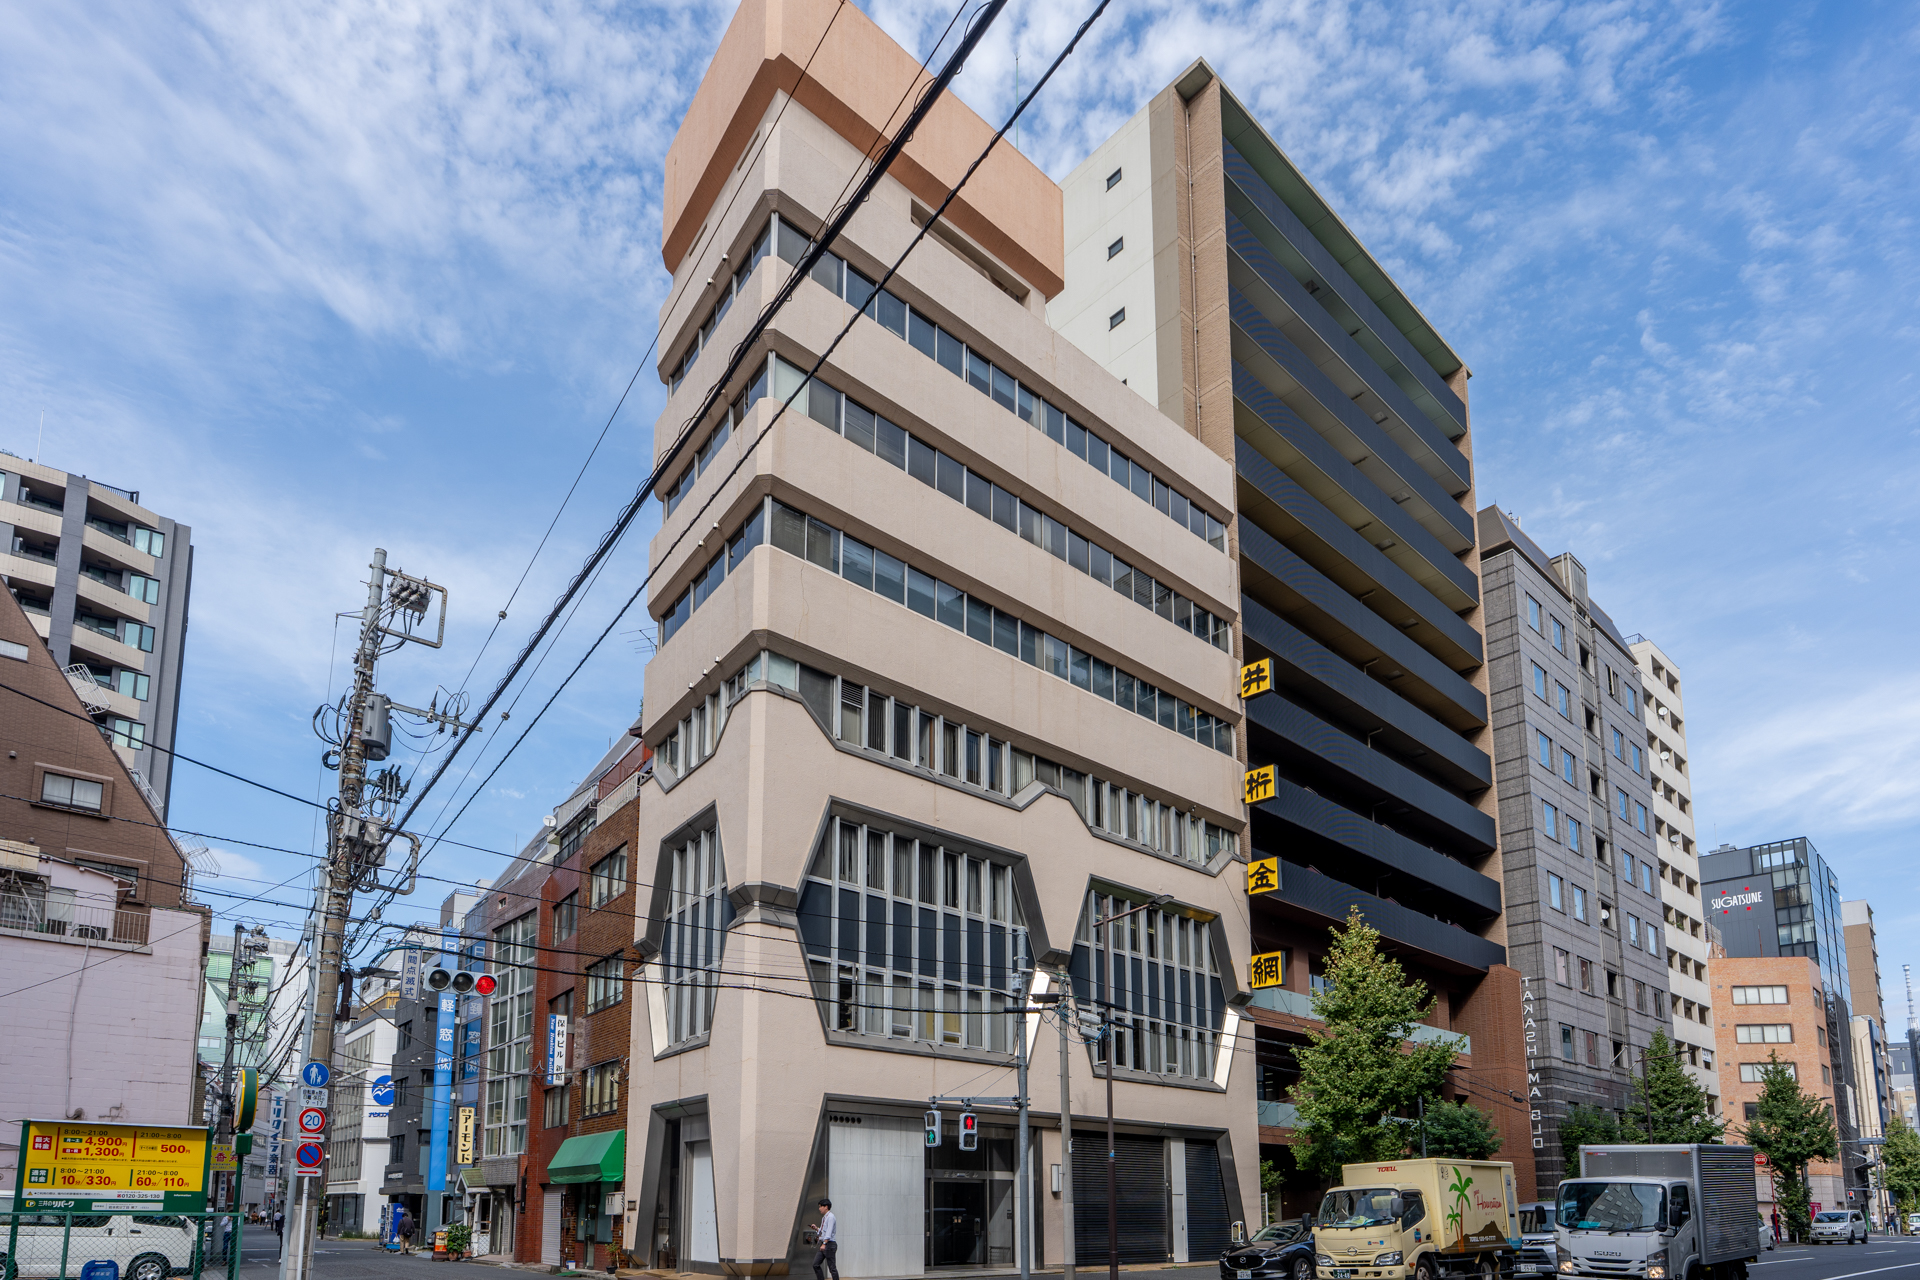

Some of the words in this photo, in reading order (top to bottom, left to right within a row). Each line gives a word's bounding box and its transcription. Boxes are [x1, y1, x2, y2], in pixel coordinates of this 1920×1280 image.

[1711, 891, 1763, 909] SUGATSUNE
[304, 1114, 321, 1127] 20
[460, 1114, 472, 1163] アーモンド
[160, 1144, 190, 1154] 500円
[38, 1200, 75, 1208] 三井のリパーク
